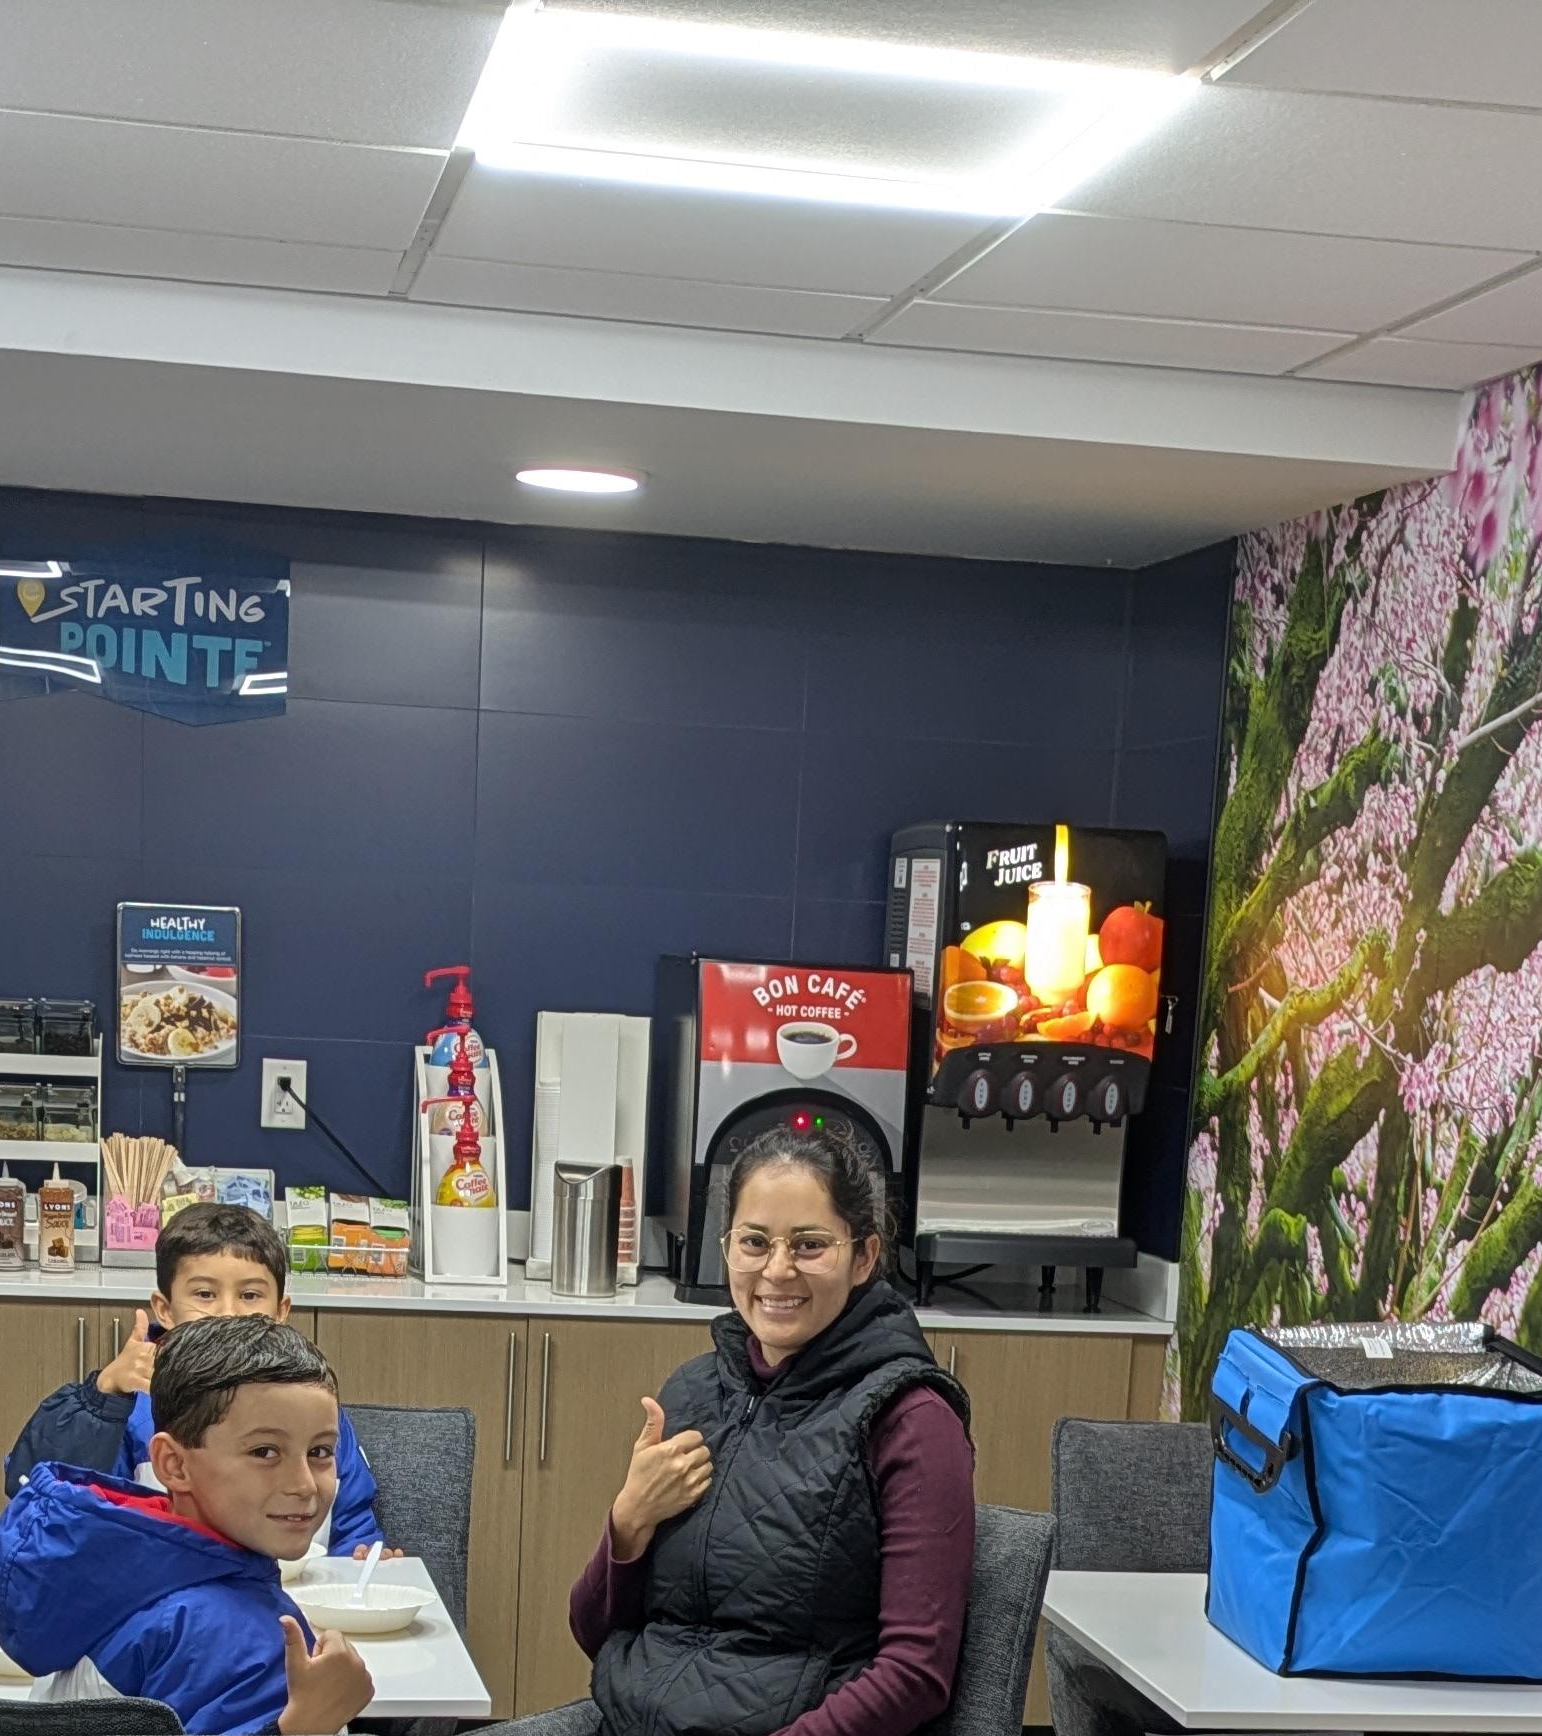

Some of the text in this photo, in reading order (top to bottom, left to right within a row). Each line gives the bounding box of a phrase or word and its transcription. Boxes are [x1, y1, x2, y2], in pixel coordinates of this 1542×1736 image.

[30, 576, 266, 626] STARTING
[61, 622, 264, 689] POINTE
[985, 842, 1038, 870] FRUIT
[993, 861, 1043, 887] JUICE
[150, 916, 206, 931] HEALTHY
[141, 928, 215, 942] INDULGENCE
[752, 975, 800, 1007] BON
[775, 1004, 842, 1019] HOT COFFEE
[454, 1042, 481, 1052] Cffee
[455, 1177, 487, 1191] Coffee
